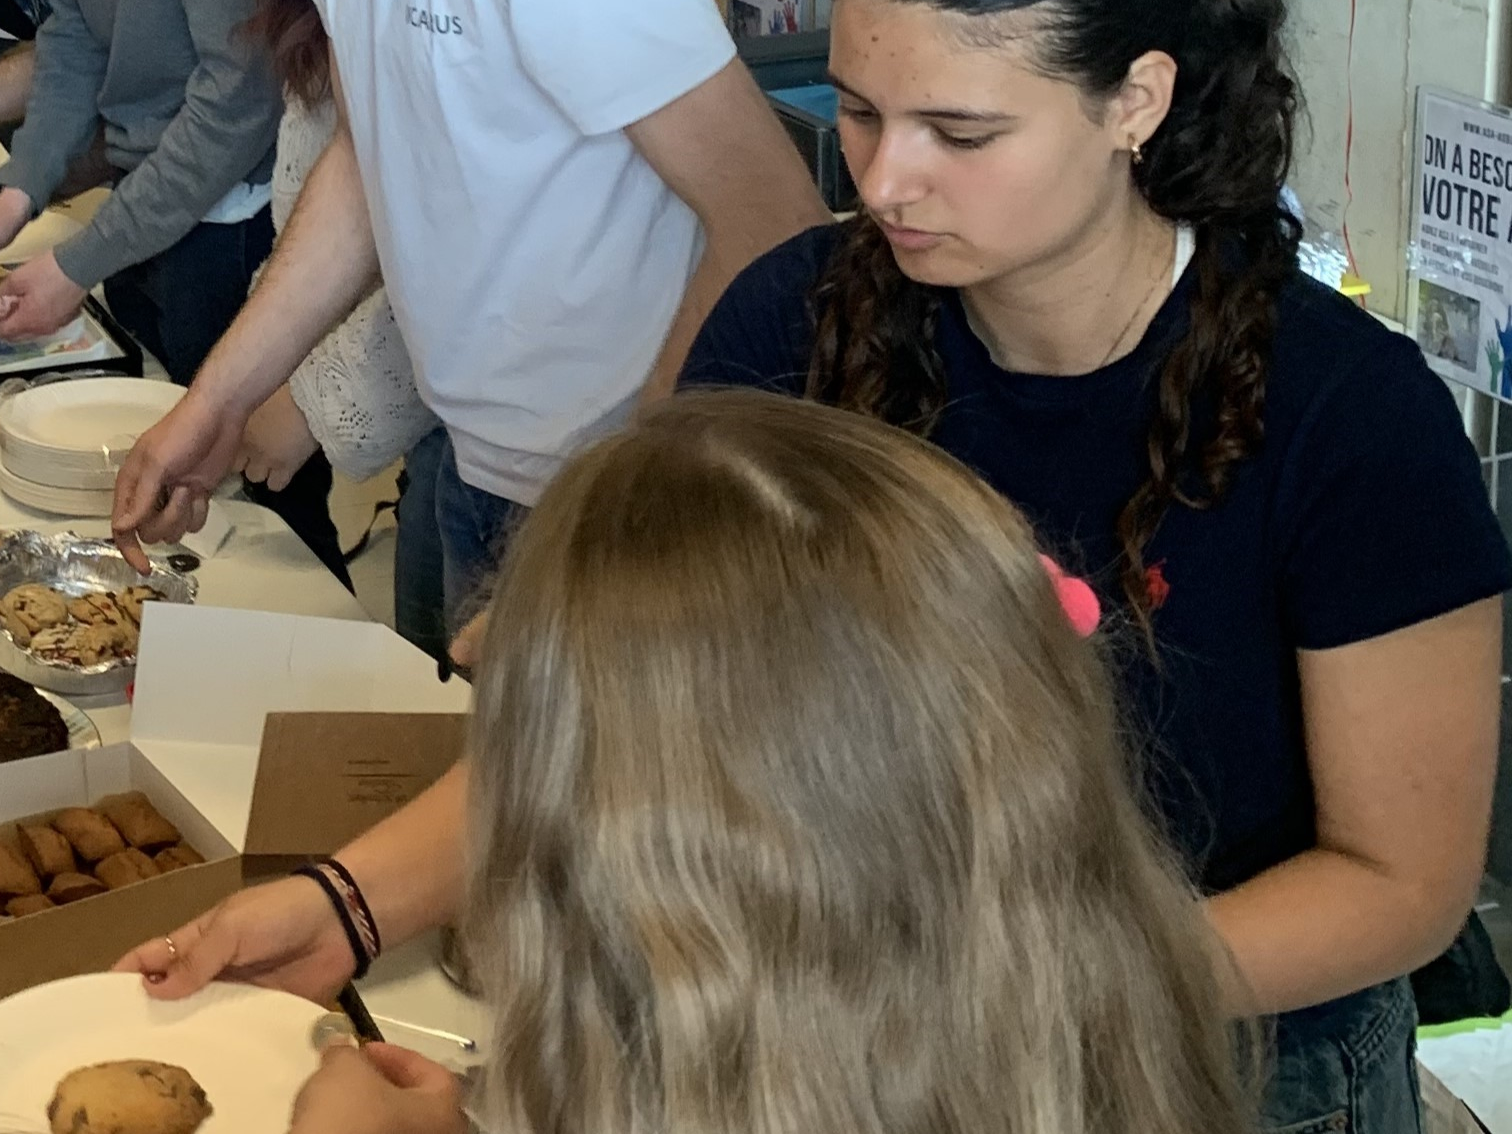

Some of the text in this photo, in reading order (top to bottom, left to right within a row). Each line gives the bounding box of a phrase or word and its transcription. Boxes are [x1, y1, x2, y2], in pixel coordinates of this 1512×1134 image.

[1424, 133, 1446, 170] ON
[1451, 143, 1463, 177] A
[1422, 173, 1501, 240] VOTRE
